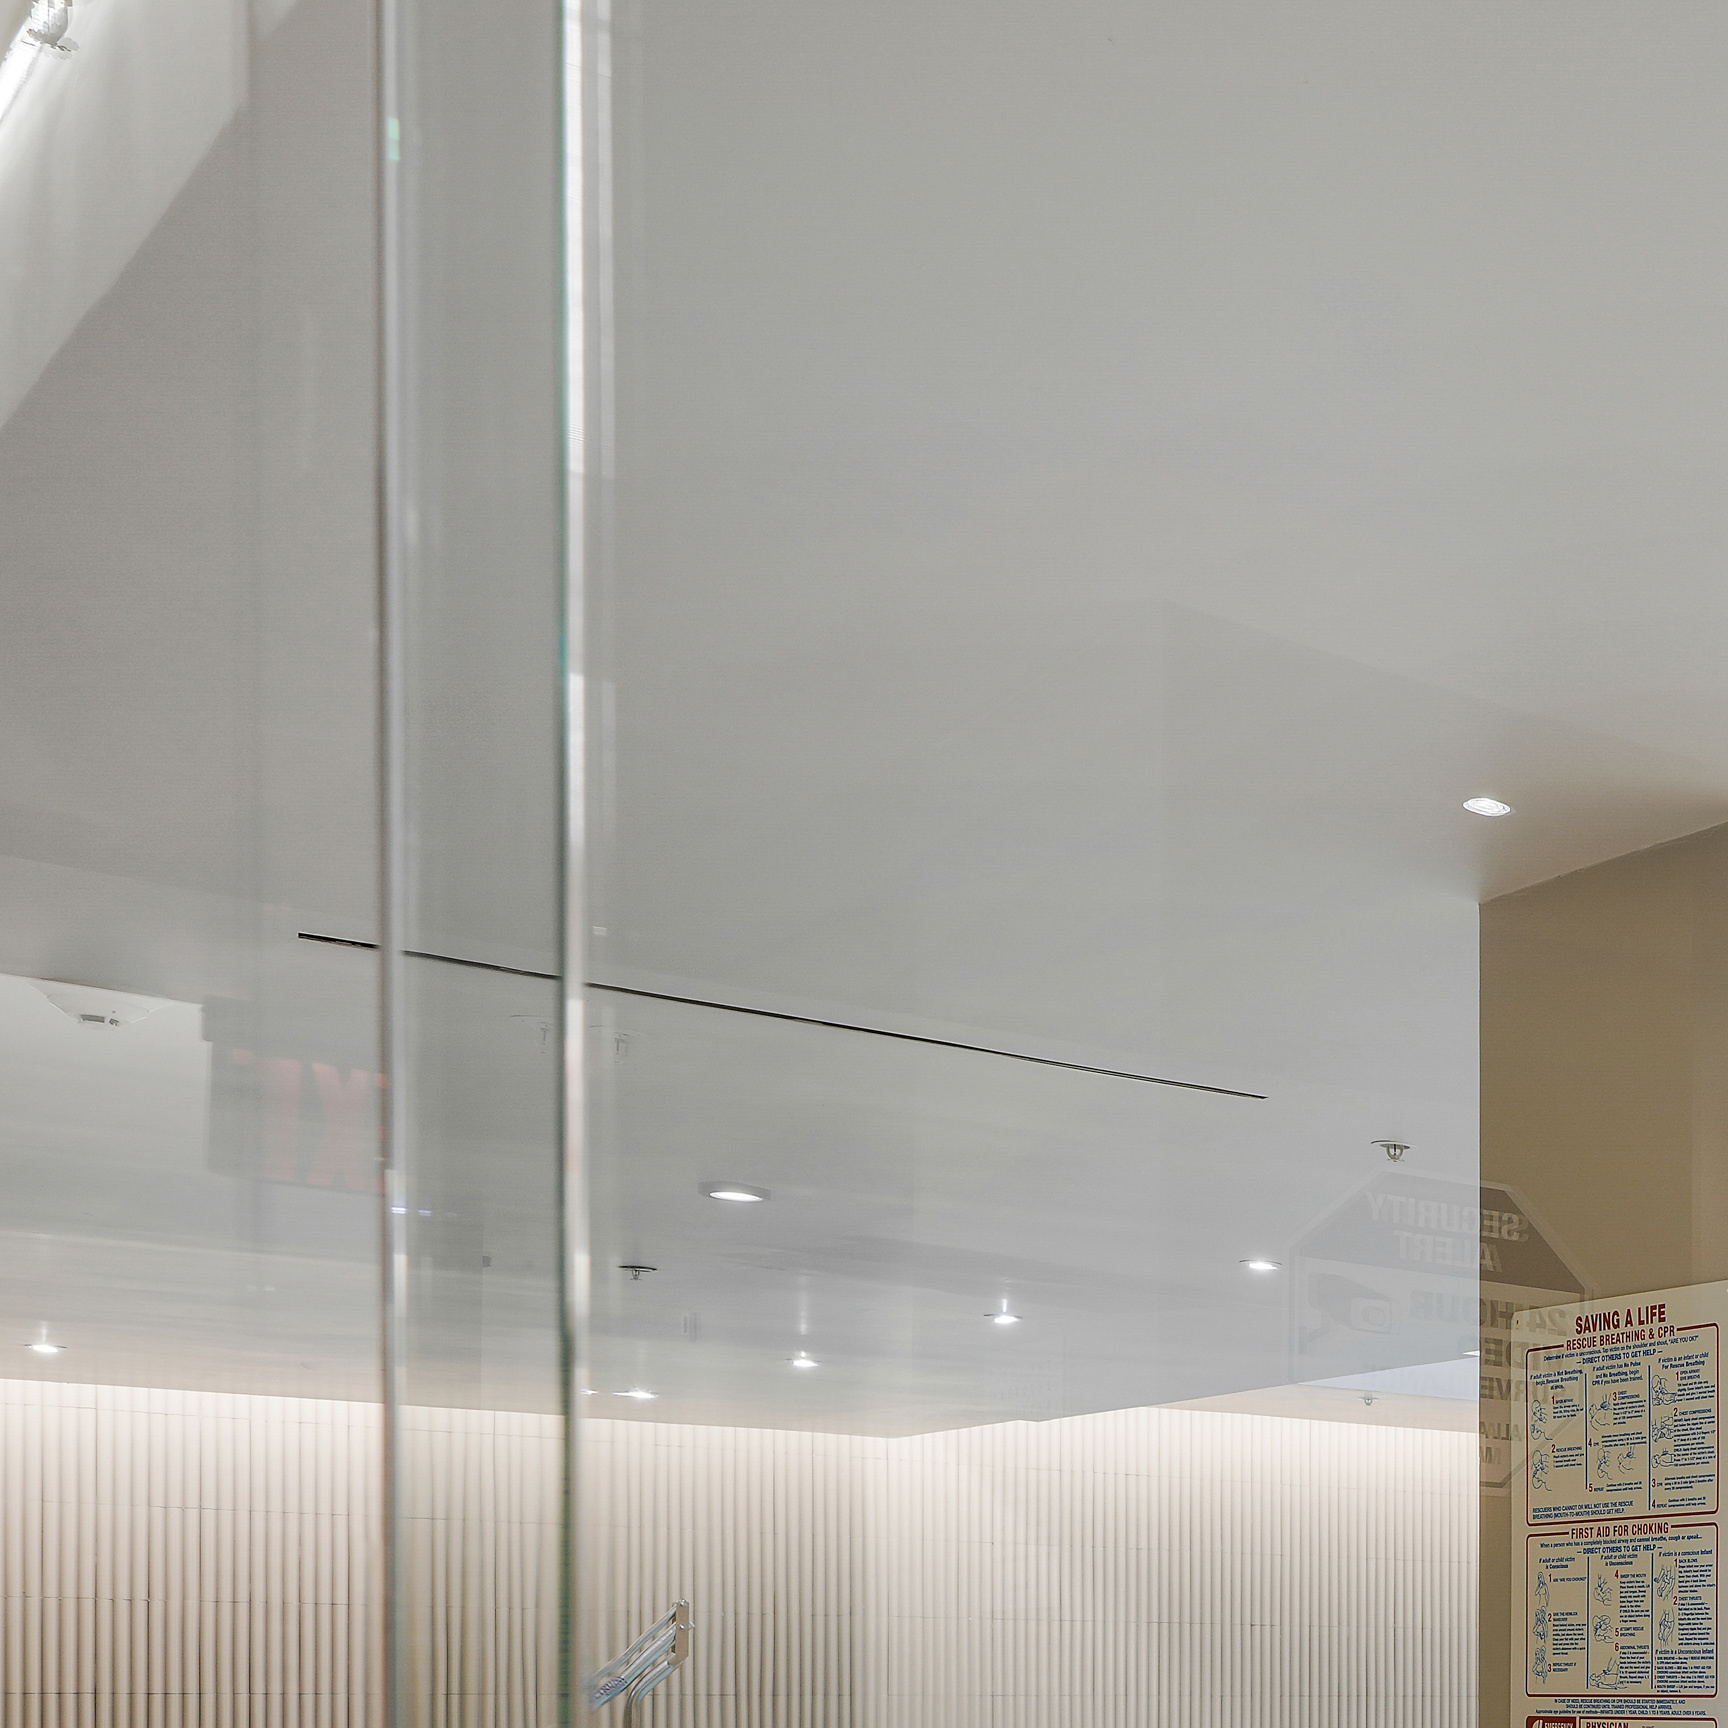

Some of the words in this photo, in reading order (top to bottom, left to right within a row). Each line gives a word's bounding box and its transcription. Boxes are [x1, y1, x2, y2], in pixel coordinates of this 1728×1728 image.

[1575, 1311, 1620, 1334] SAVING
[1625, 1309, 1633, 1327] A
[1638, 1303, 1666, 1326] LIFE
[1567, 1336, 1597, 1350] RESCUE
[1600, 1329, 1645, 1348] BREATHING
[1649, 1328, 1654, 1339] &
[1658, 1325, 1675, 1338] CPR
[1583, 1355, 1600, 1365] DIRECT
[1602, 1353, 1621, 1362] OTHERS
[1676, 1371, 1679, 1381] 1
[1551, 1395, 1555, 1404] 1
[1613, 1392, 1617, 1401] 3
[1674, 1408, 1678, 1417] 2
[1588, 1438, 1592, 1447] 4
[1552, 1444, 1555, 1453] 2
[1589, 1483, 1593, 1492] 5
[1652, 1479, 1656, 1487] 3
[1652, 1499, 1655, 1508] 4
[1571, 1527, 1594, 1539] FIRST
[1596, 1526, 1610, 1538] AID
[1613, 1525, 1629, 1536] FOR
[1632, 1522, 1669, 1535] CHOKING
[1674, 1559, 1677, 1568] 1
[1549, 1574, 1552, 1582] 1
[1615, 1570, 1619, 1579] 4
[1673, 1596, 1677, 1605] 2
[1548, 1613, 1552, 1622] 2
[1615, 1628, 1619, 1637] 5
[1615, 1643, 1619, 1651] 6
[1548, 1663, 1551, 1672] 3
